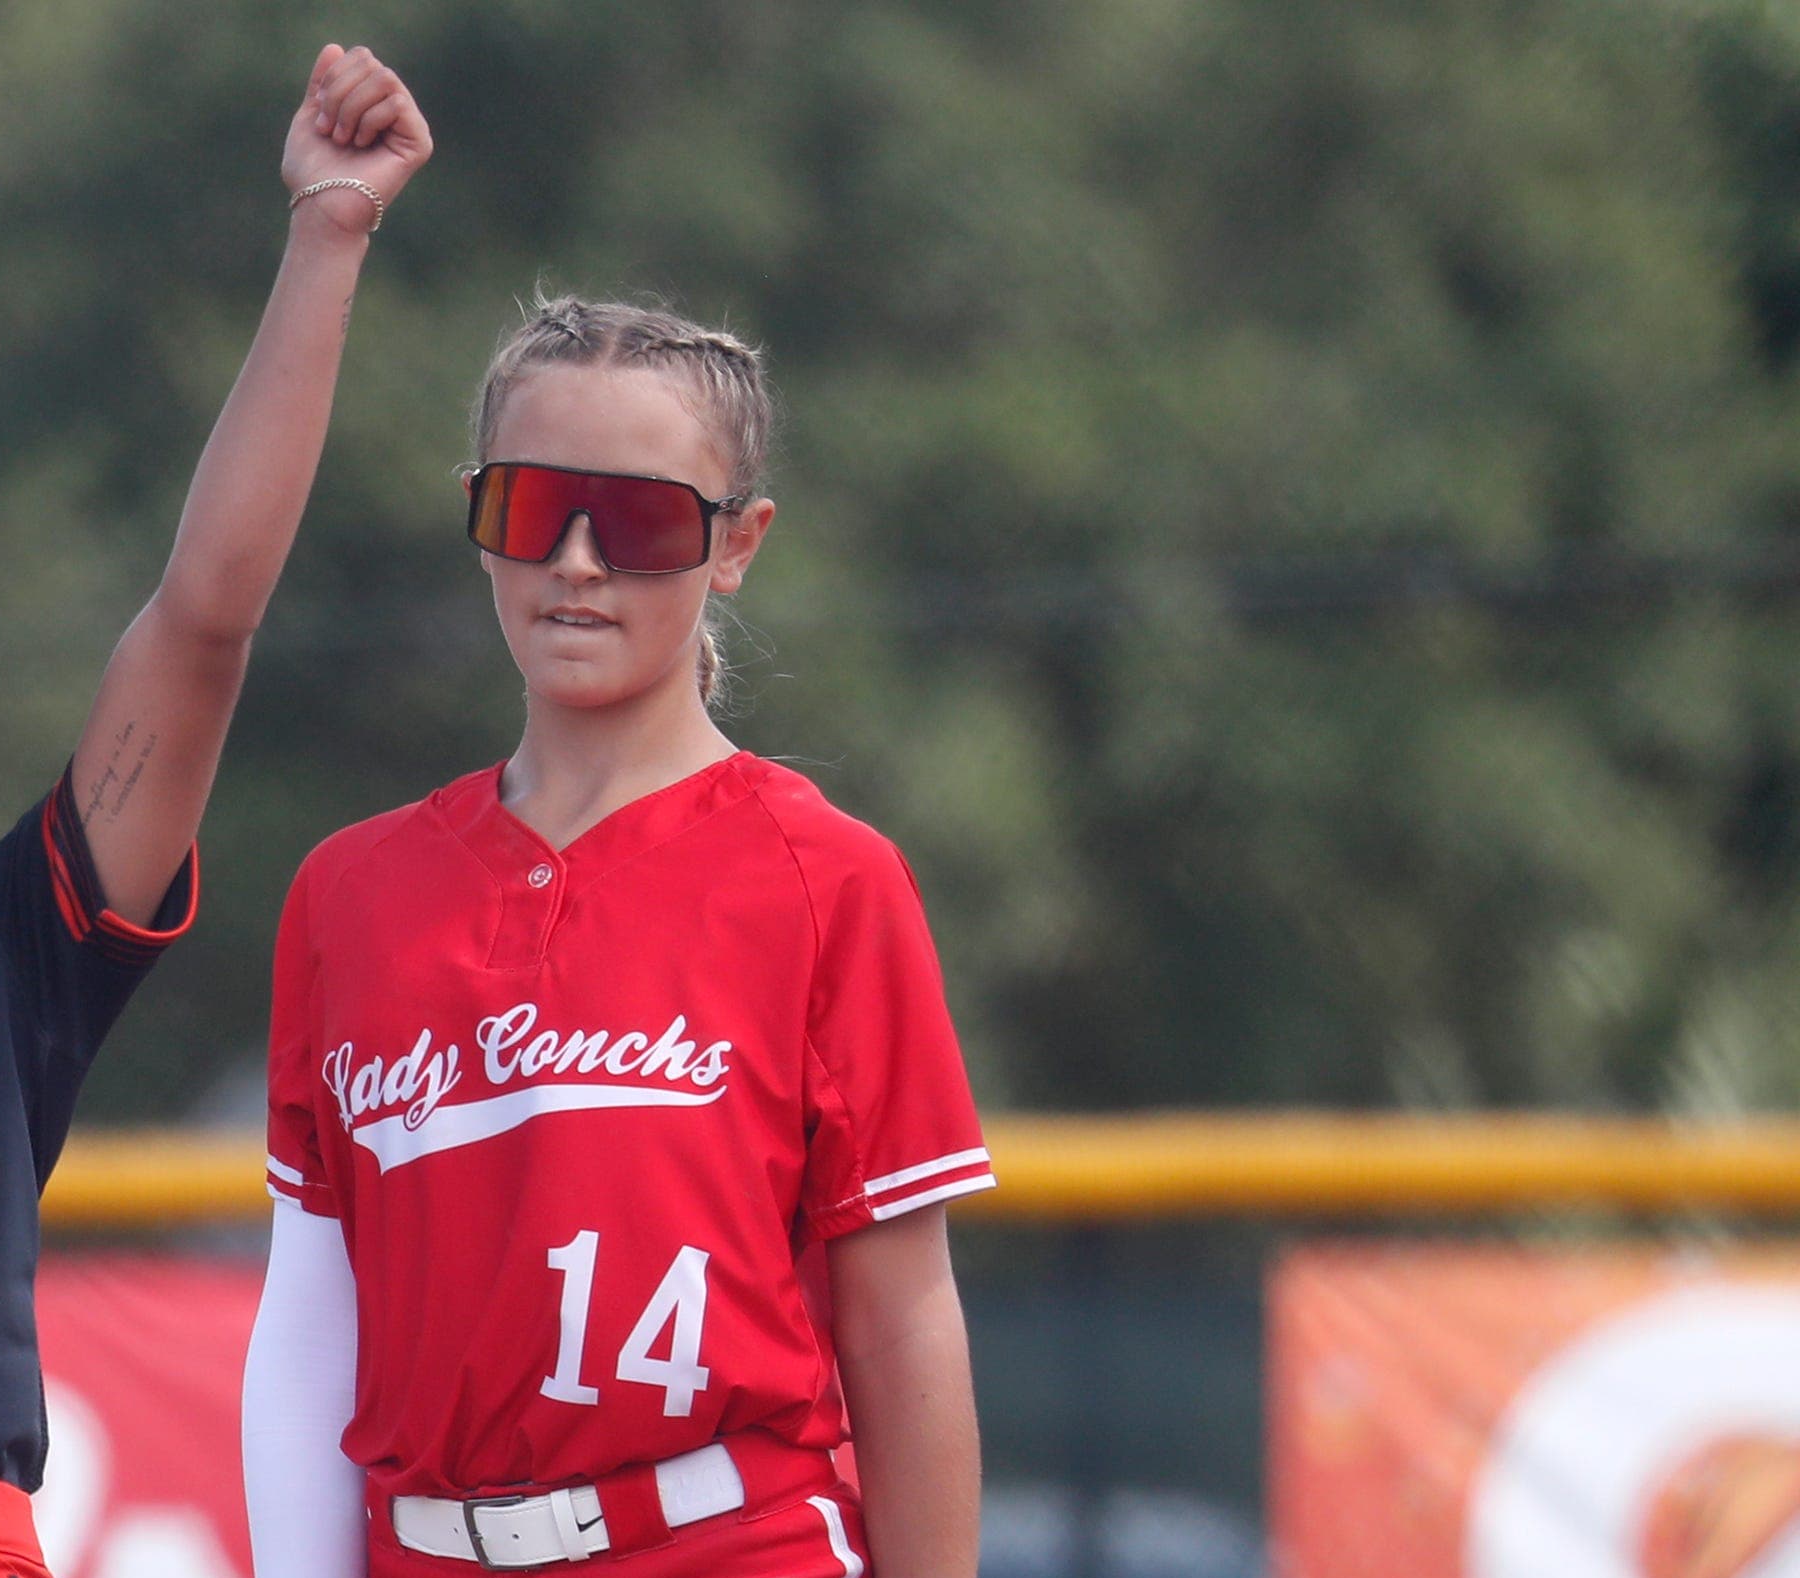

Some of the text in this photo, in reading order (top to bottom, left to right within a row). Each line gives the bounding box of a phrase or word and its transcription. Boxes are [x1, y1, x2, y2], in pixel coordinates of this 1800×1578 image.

[322, 1002, 732, 1133] Lady Conchs
[539, 1229, 711, 1418] 14
